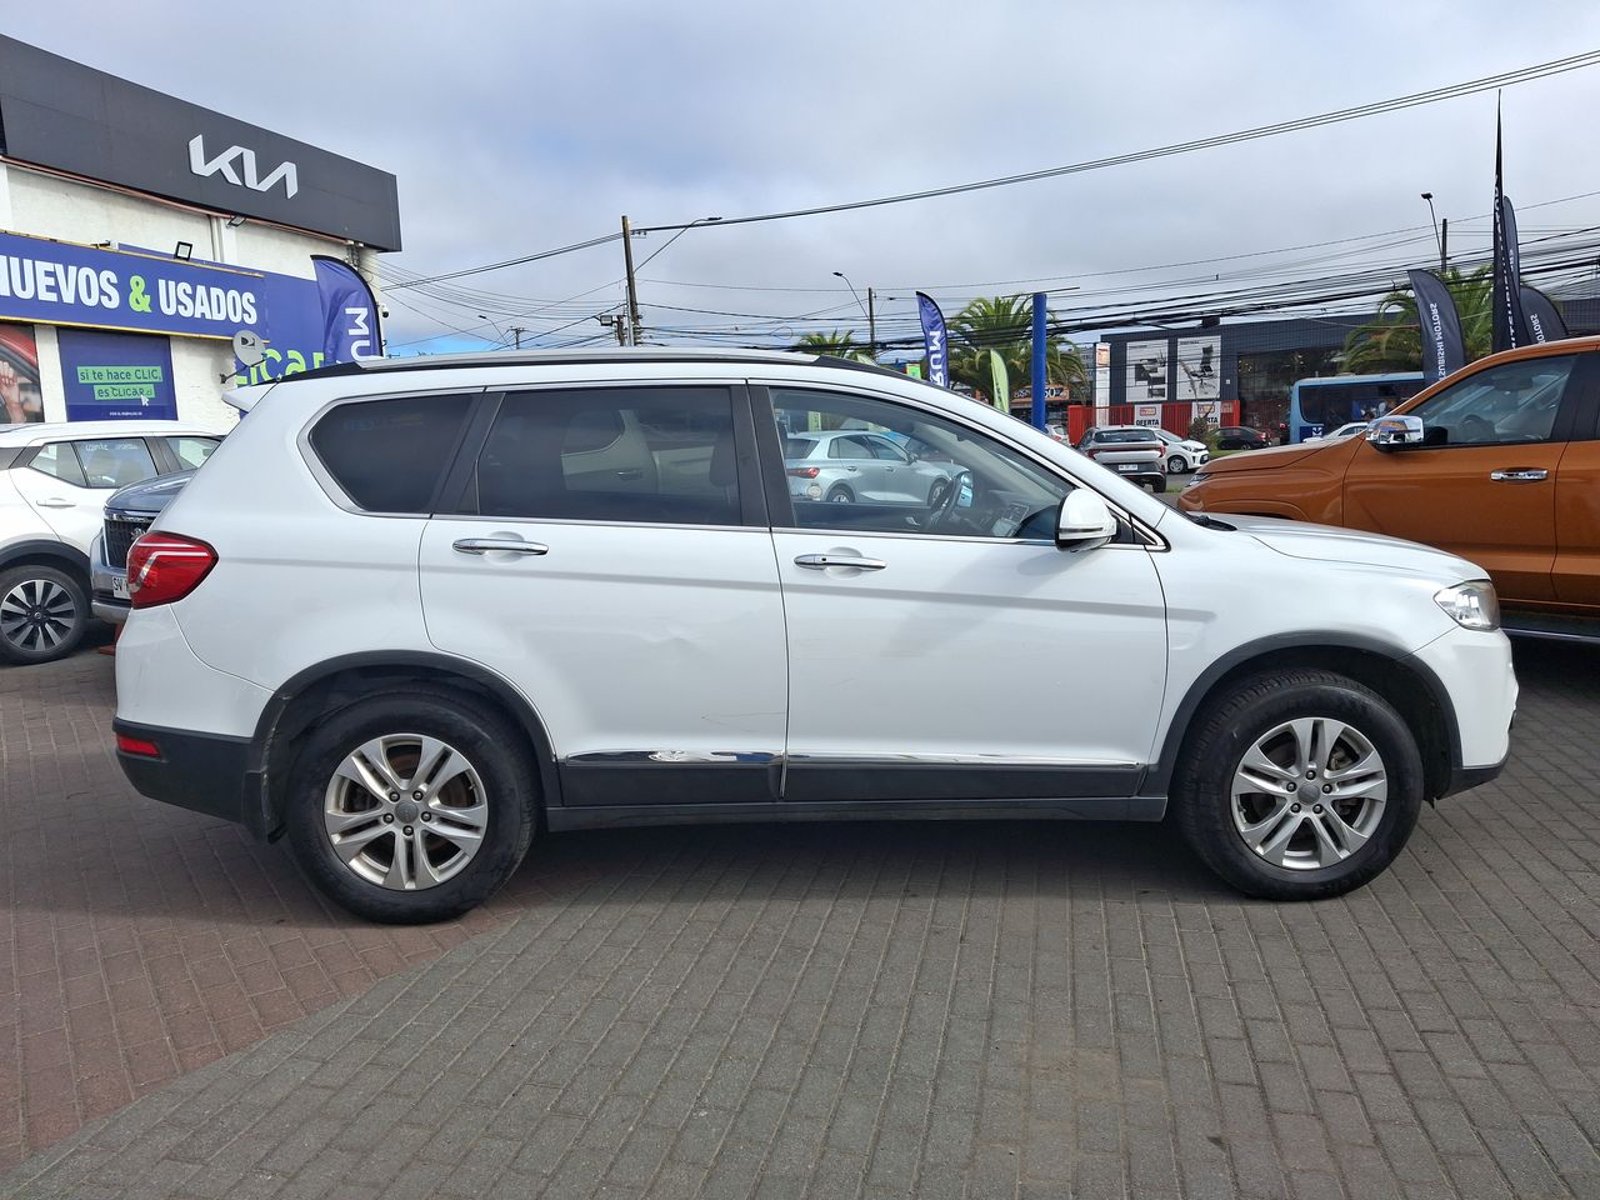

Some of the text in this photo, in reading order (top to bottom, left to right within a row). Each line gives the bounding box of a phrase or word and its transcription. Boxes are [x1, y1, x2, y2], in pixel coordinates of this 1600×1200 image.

[188, 133, 298, 199] KIA
[129, 275, 152, 312] &
[158, 278, 257, 325] USADOS
[80, 369, 89, 381] si
[92, 369, 103, 381] te
[106, 368, 131, 381] hace
[98, 389, 110, 398] es
